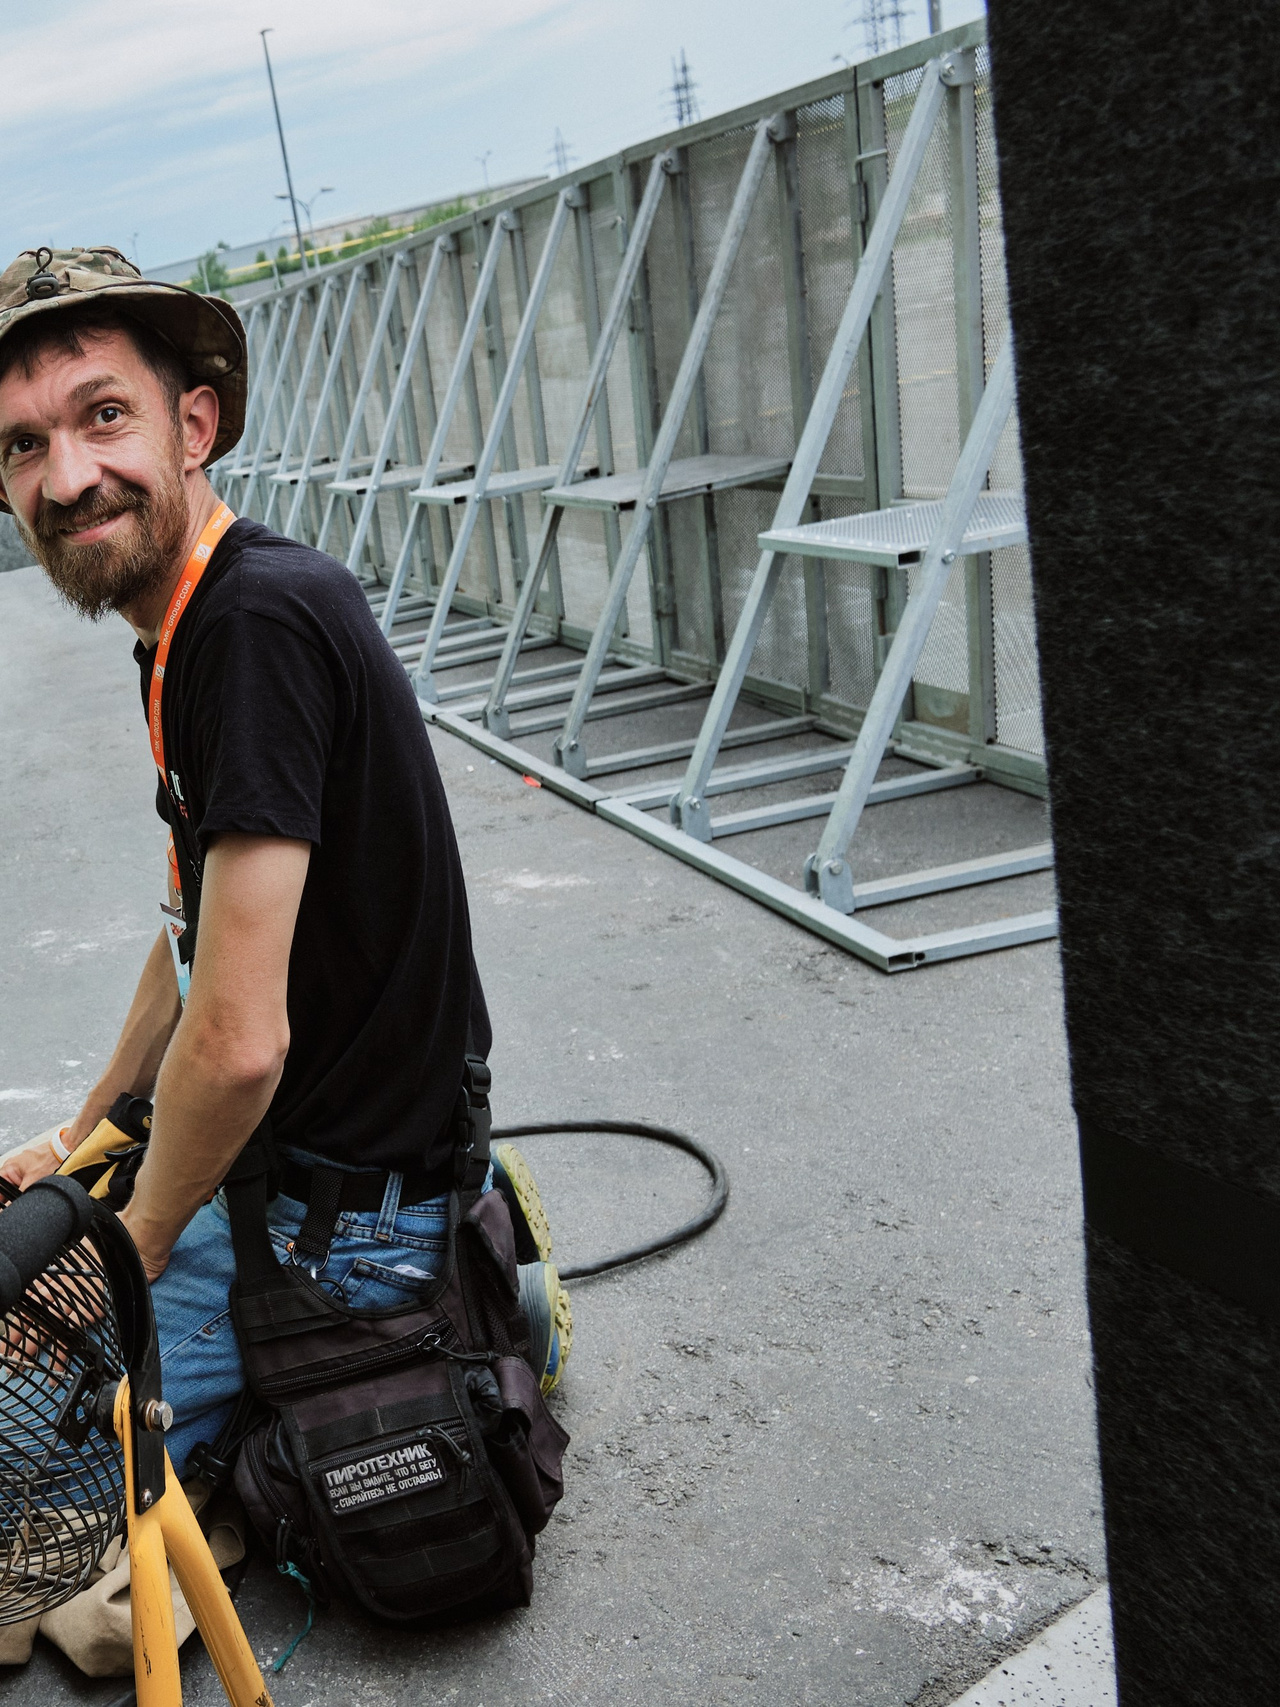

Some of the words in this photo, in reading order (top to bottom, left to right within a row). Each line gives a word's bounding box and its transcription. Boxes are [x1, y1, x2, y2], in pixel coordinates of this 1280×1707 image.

[162, 580, 192, 646] TMK-GROUP.COM
[325, 1443, 433, 1487] ПИРОТЕХНИК
[329, 1486, 348, 1499] ЕСЛИ
[350, 1481, 362, 1492] ВЫ
[395, 1467, 410, 1478] ЧТО
[411, 1463, 418, 1474] Я
[419, 1458, 437, 1471] БЕГУ
[339, 1487, 385, 1508] СТАРАЙТЕСЬ
[386, 1483, 398, 1495] НЕ
[399, 1468, 443, 1490] ОТСТАВАТЬ!
